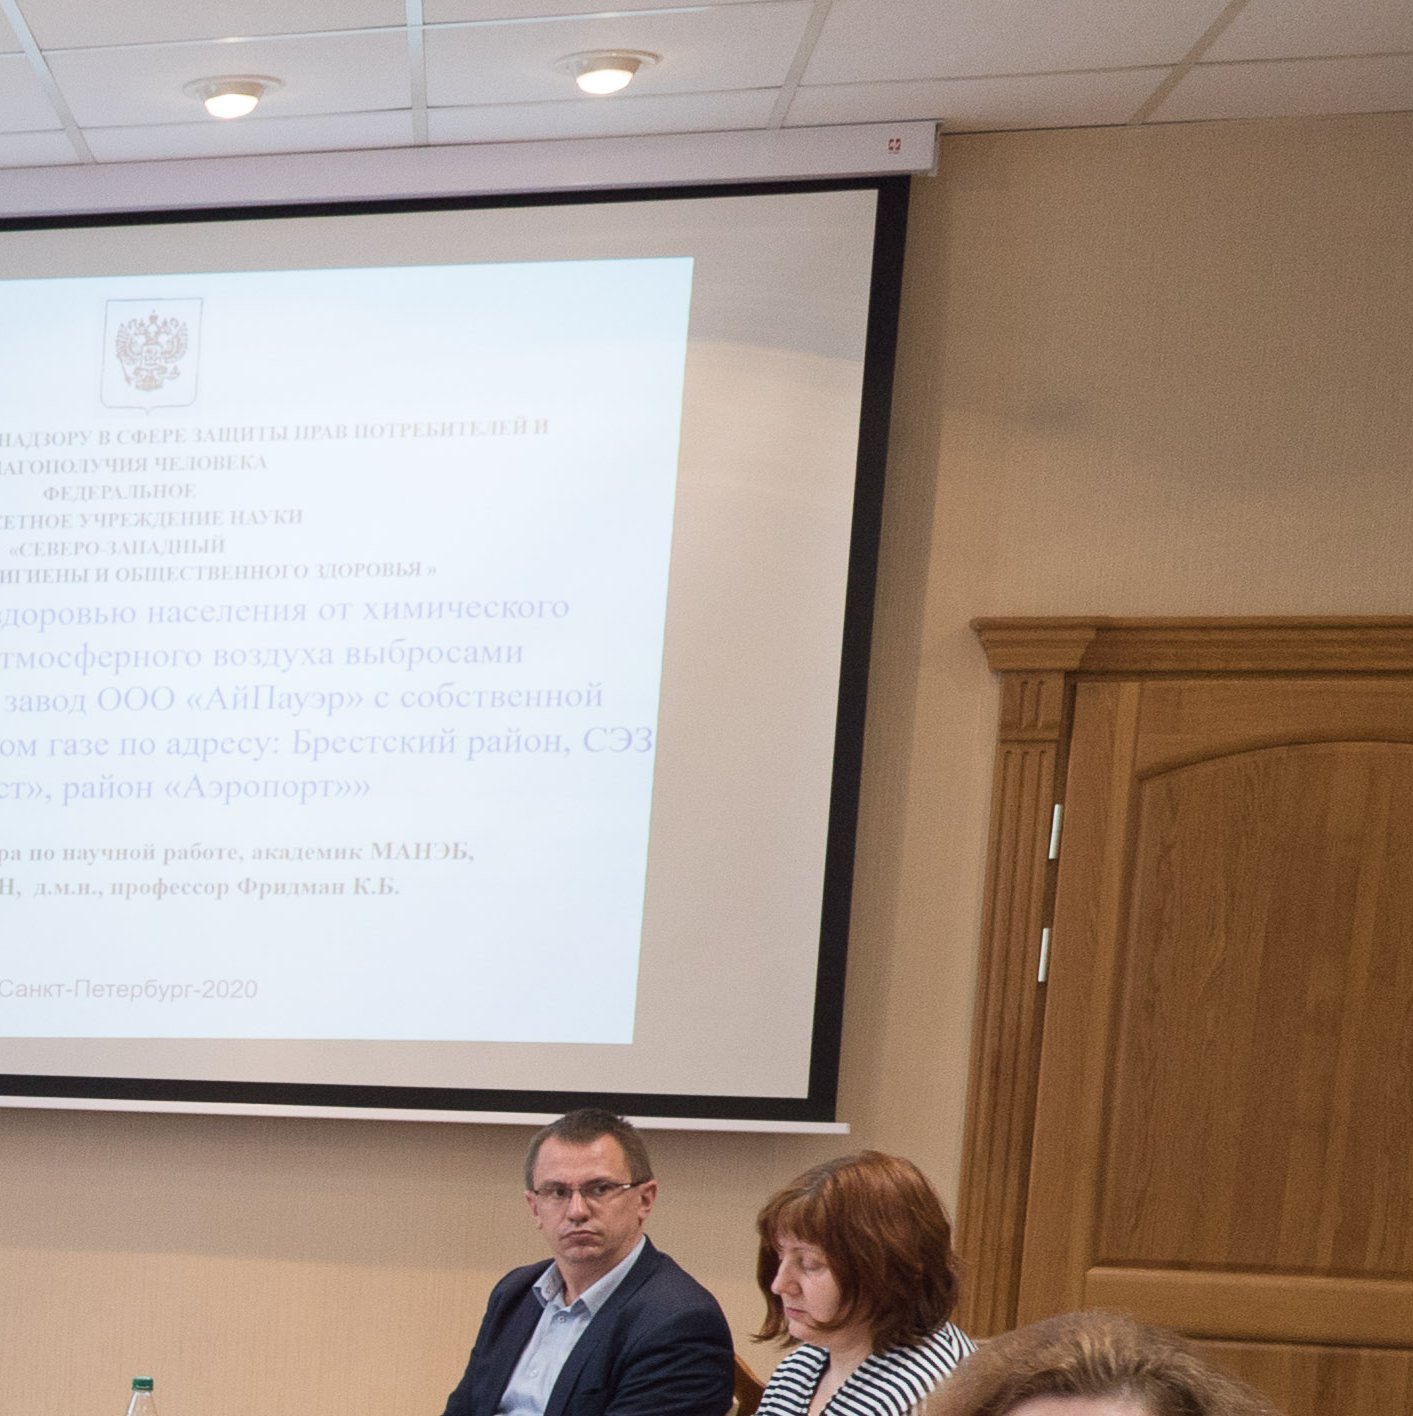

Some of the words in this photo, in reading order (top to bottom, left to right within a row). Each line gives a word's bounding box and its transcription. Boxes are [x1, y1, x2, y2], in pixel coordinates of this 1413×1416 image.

[97, 429, 112, 447] В
[114, 427, 188, 447] СФЕРЕ
[192, 424, 289, 445] ЗАЩИТЫ
[293, 423, 349, 442] ПРАВ
[353, 415, 528, 441] ПОТРЕБИТЕЛЕЙ
[533, 418, 549, 435] И
[153, 453, 268, 473] ЧЕЛОВЕКА
[41, 482, 196, 504] ФЕДЕРАЛЬНОЕ
[78, 509, 224, 530] УЧРЕЖДЕНИЕ
[229, 508, 304, 527] НАУКИ
[94, 566, 110, 584] И
[114, 563, 310, 584] ОБЩЕСТВЕННОГО
[317, 560, 423, 581] ЗДОРОВЬЯ
[146, 603, 308, 625] населения
[317, 601, 354, 622] от
[361, 599, 571, 622] химического
[212, 647, 334, 675] воздуха
[344, 637, 524, 673] выбросами
[4, 693, 88, 716] завод
[95, 685, 177, 713] ООО
[184, 683, 365, 719] «АйПауэр»
[372, 690, 391, 710] с
[398, 680, 603, 710] собственной
[48, 737, 110, 758] газе
[118, 736, 157, 757] по
[165, 735, 280, 764] адресу:
[291, 727, 457, 763] Брестский
[465, 726, 572, 762] район,
[581, 725, 655, 754] СЭЗ
[61, 773, 154, 808] район
[28, 847, 57, 863] по
[61, 842, 156, 867] научной
[161, 841, 245, 867] работе,
[250, 846, 364, 863] академик
[109, 876, 231, 902] профессор
[235, 876, 346, 902] Фридман
[352, 875, 401, 896] К.Б.
